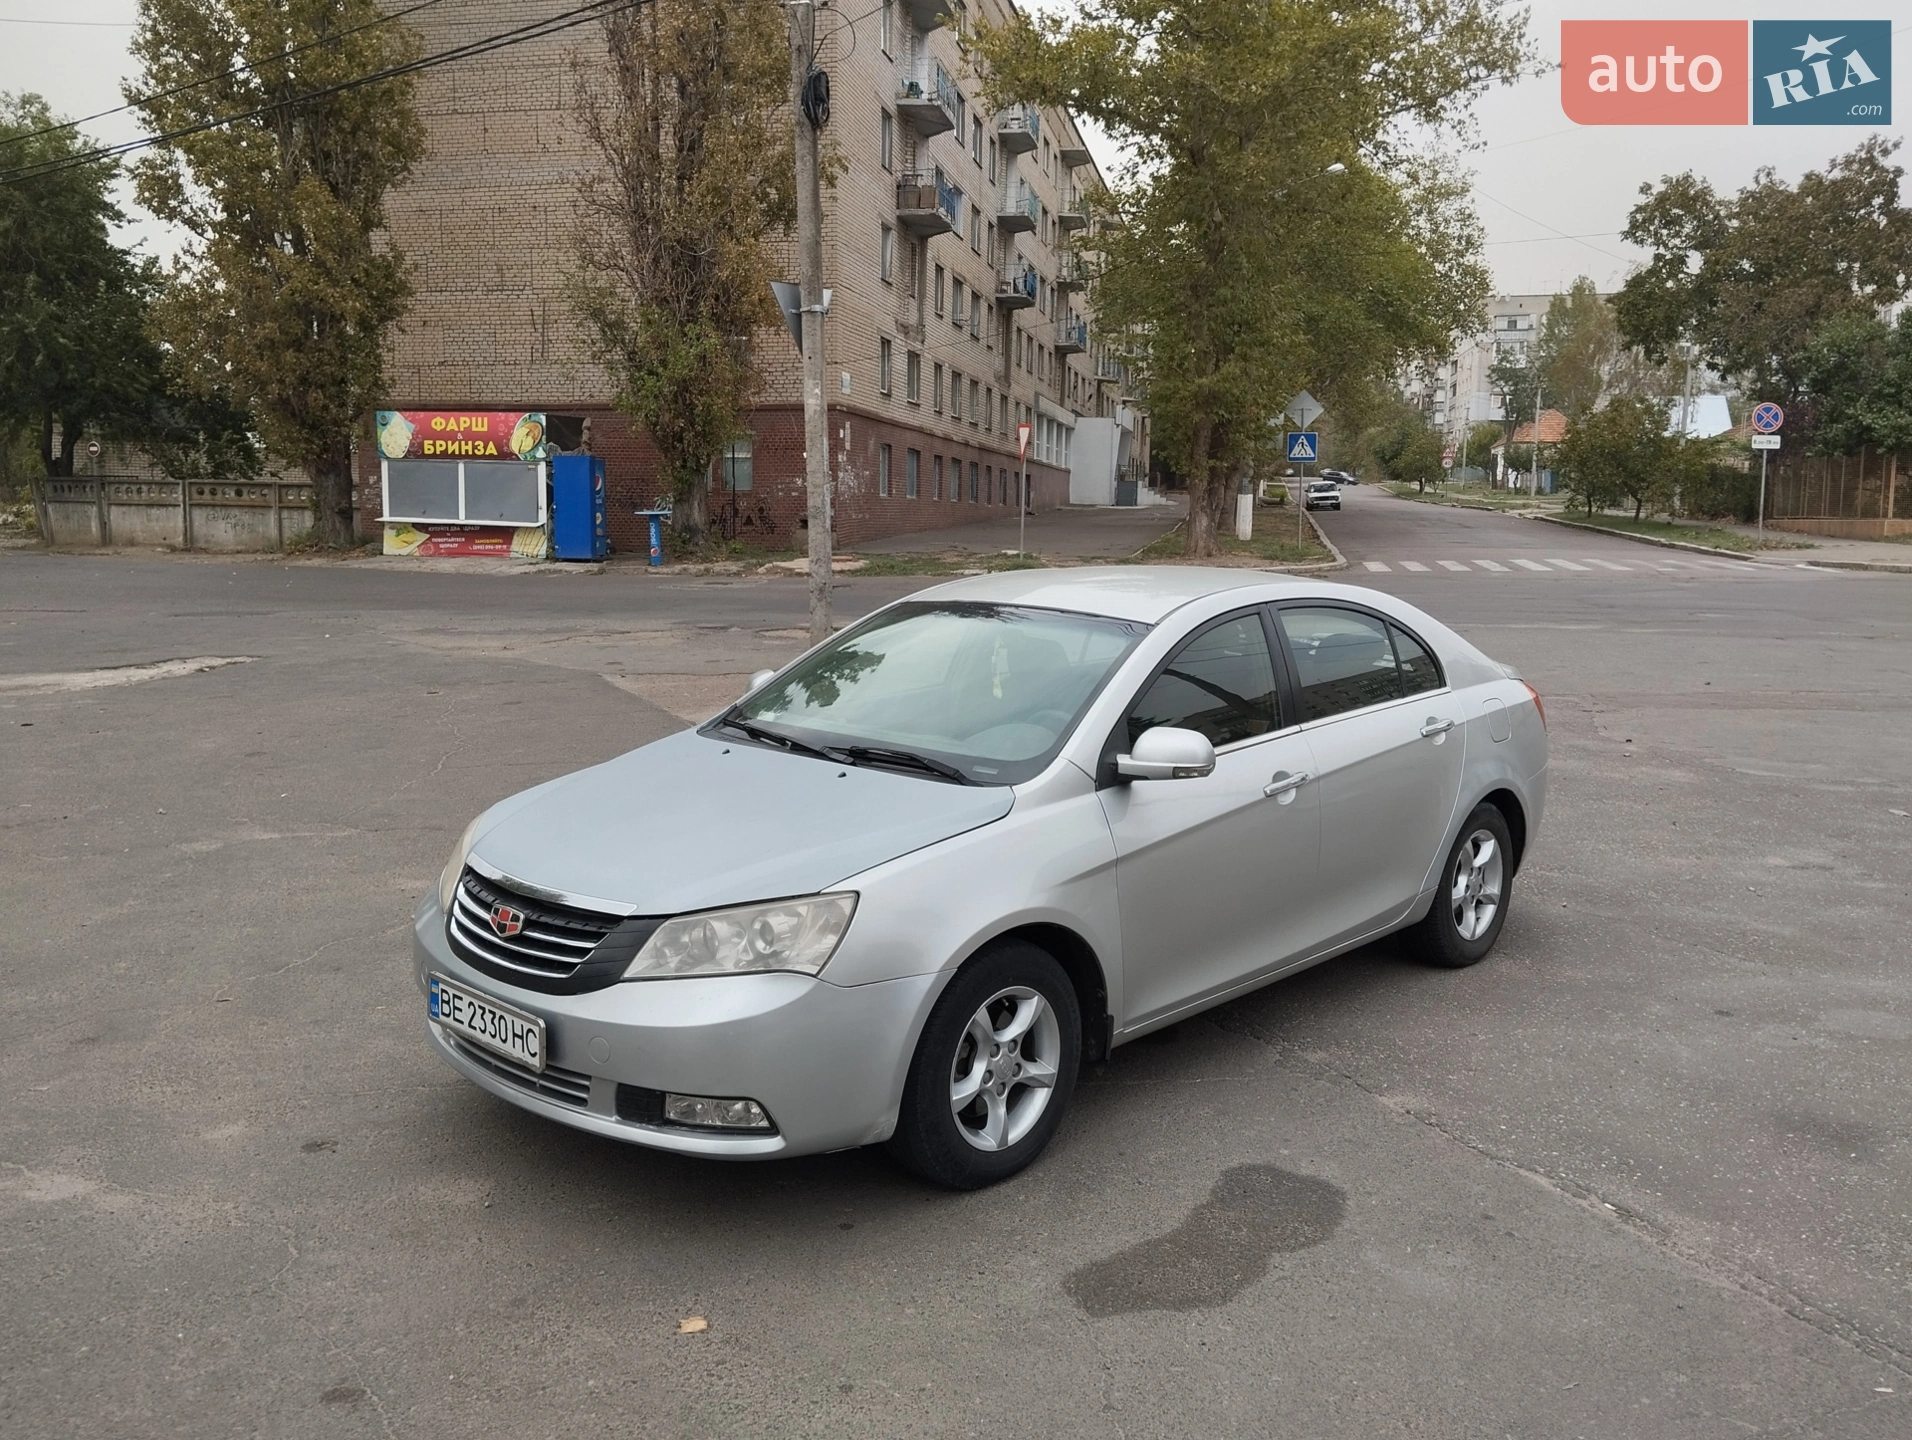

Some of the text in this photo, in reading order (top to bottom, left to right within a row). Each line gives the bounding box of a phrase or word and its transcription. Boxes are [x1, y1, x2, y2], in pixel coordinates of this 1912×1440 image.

[430, 416, 488, 432] ФАРШ
[423, 439, 498, 456] БРИНЗА
[649, 522, 657, 544] pepsi
[431, 987, 538, 1058] UA BE 2330 HC
